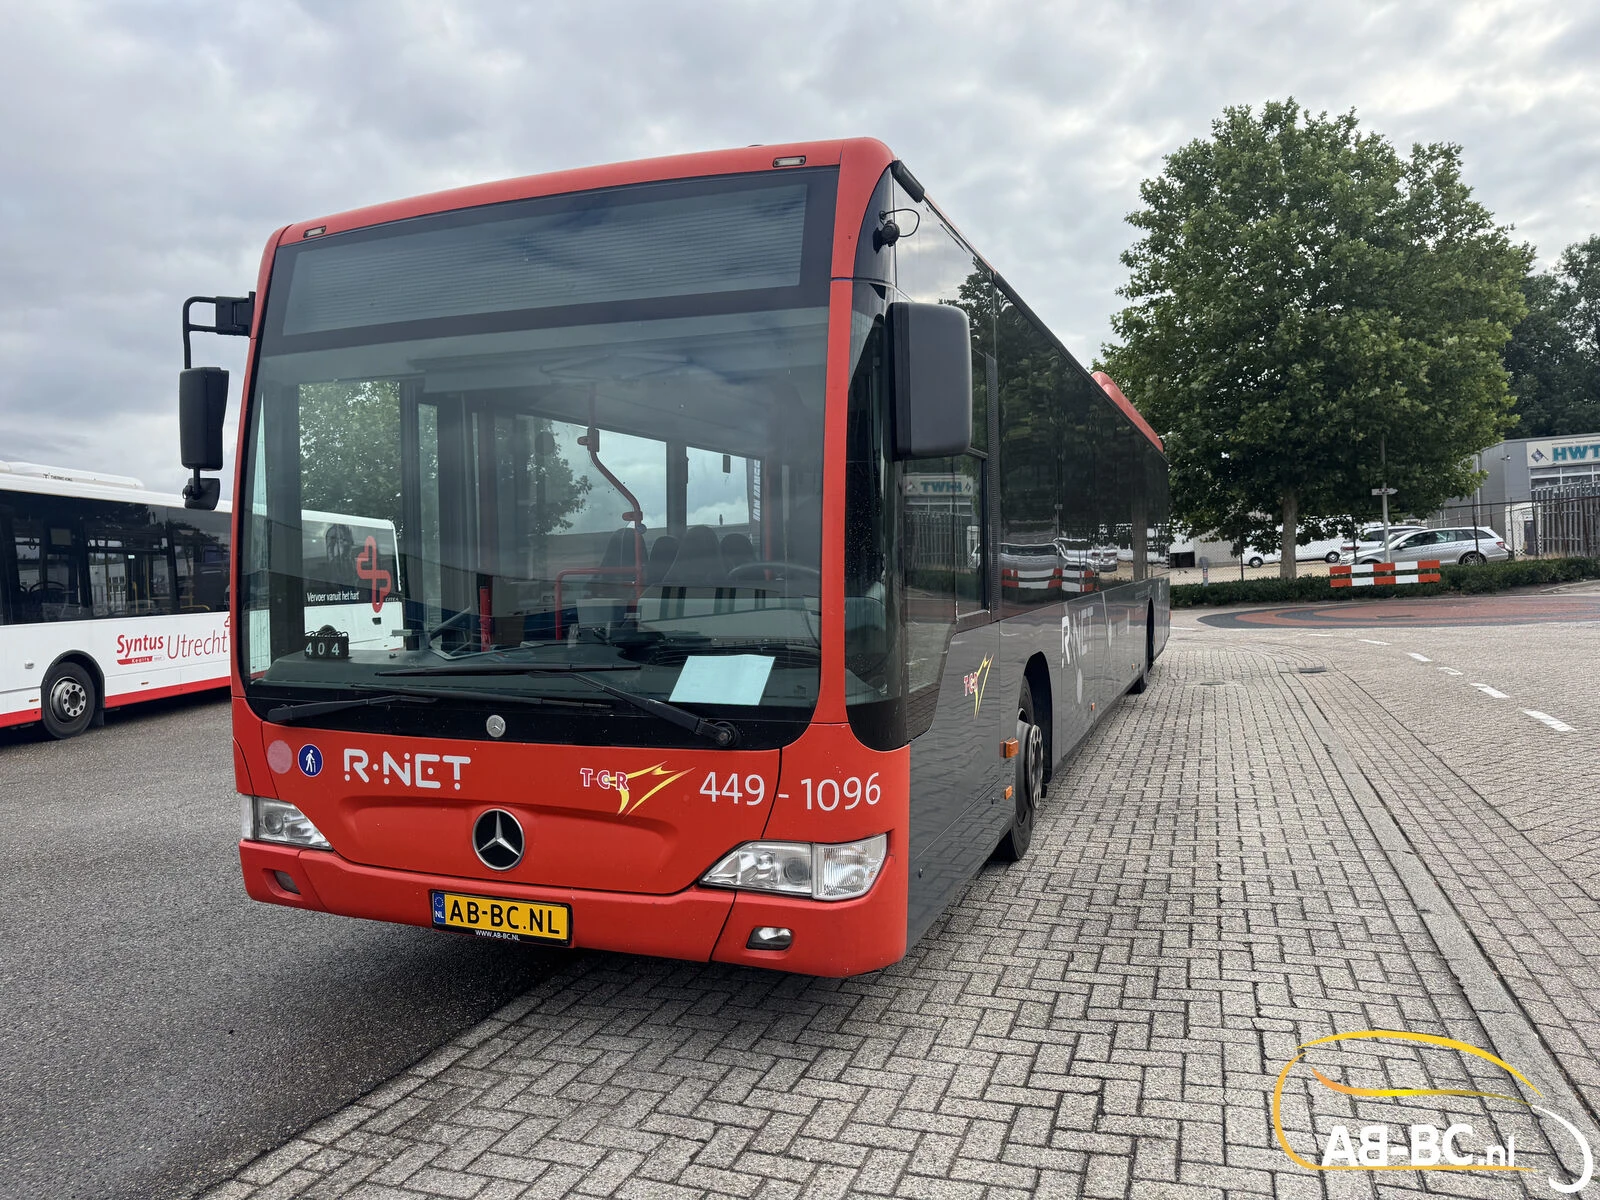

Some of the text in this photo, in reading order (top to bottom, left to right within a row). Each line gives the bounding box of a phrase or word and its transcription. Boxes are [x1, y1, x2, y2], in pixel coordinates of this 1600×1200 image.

[307, 592, 327, 602] Vervoer
[116, 629, 227, 660] Syntus Utrecht
[699, 771, 765, 806] 449
[800, 772, 881, 812] 1096
[434, 910, 445, 919] NL
[449, 900, 560, 935] AB-BC.NL
[475, 929, 520, 941] WWW.AB-BC.NL
